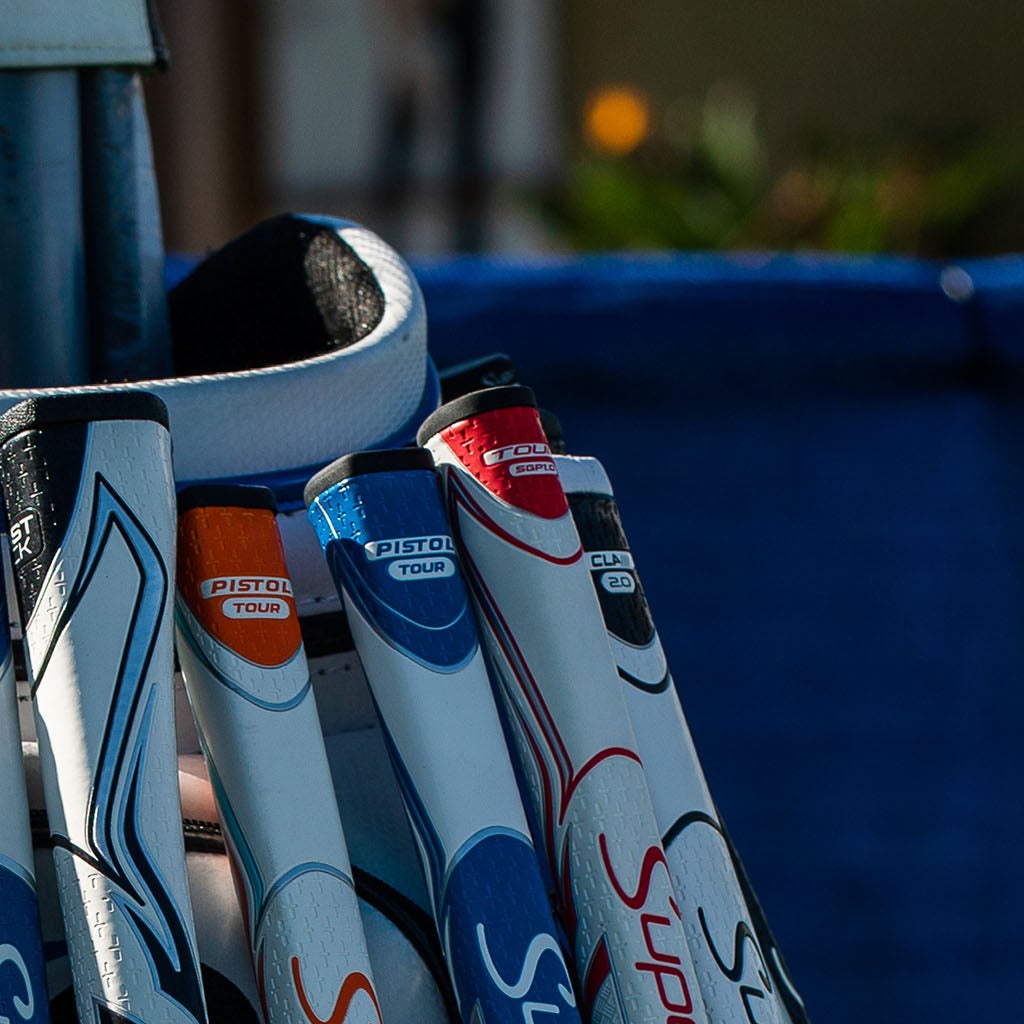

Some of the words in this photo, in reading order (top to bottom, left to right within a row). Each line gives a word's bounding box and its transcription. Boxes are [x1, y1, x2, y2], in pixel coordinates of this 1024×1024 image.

[376, 537, 455, 557] PISTOL
[398, 561, 445, 575] TOUR
[211, 579, 292, 594] PISTOL
[233, 602, 281, 614] TOUR
